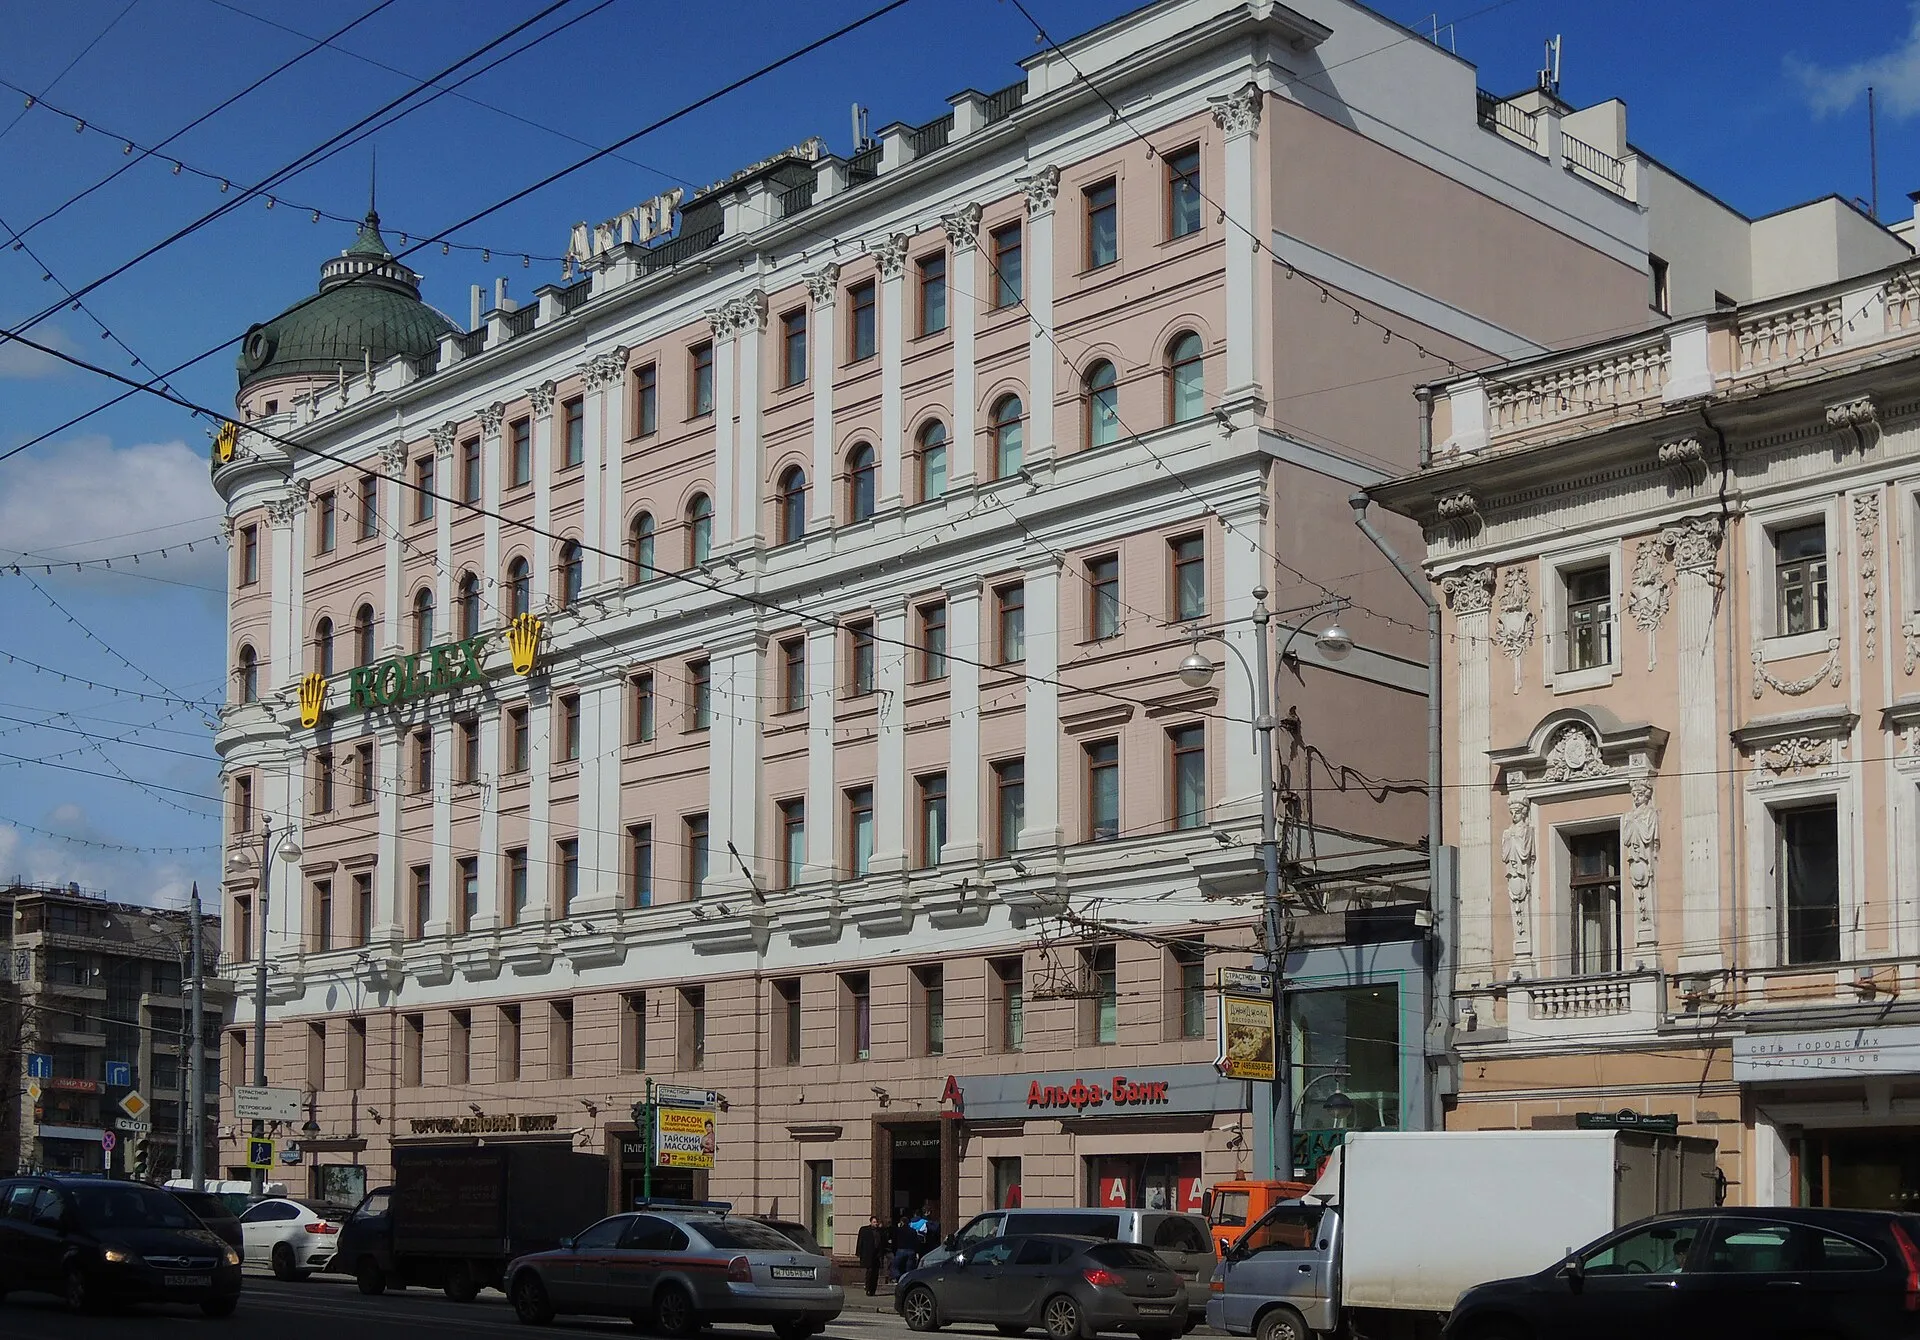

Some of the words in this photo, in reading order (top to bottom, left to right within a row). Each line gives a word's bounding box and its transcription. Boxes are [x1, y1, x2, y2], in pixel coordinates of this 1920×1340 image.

[348, 636, 488, 711] ROLEX
[1751, 1046, 1784, 1054] сеть
[1797, 1036, 1880, 1051] городских
[664, 1114, 670, 1122] 7
[671, 1115, 702, 1124] КРАСОК
[120, 1120, 148, 1131] СТОП
[663, 1134, 701, 1143] ТАЙСКИЙ
[664, 1142, 700, 1151] МАССАЖ
